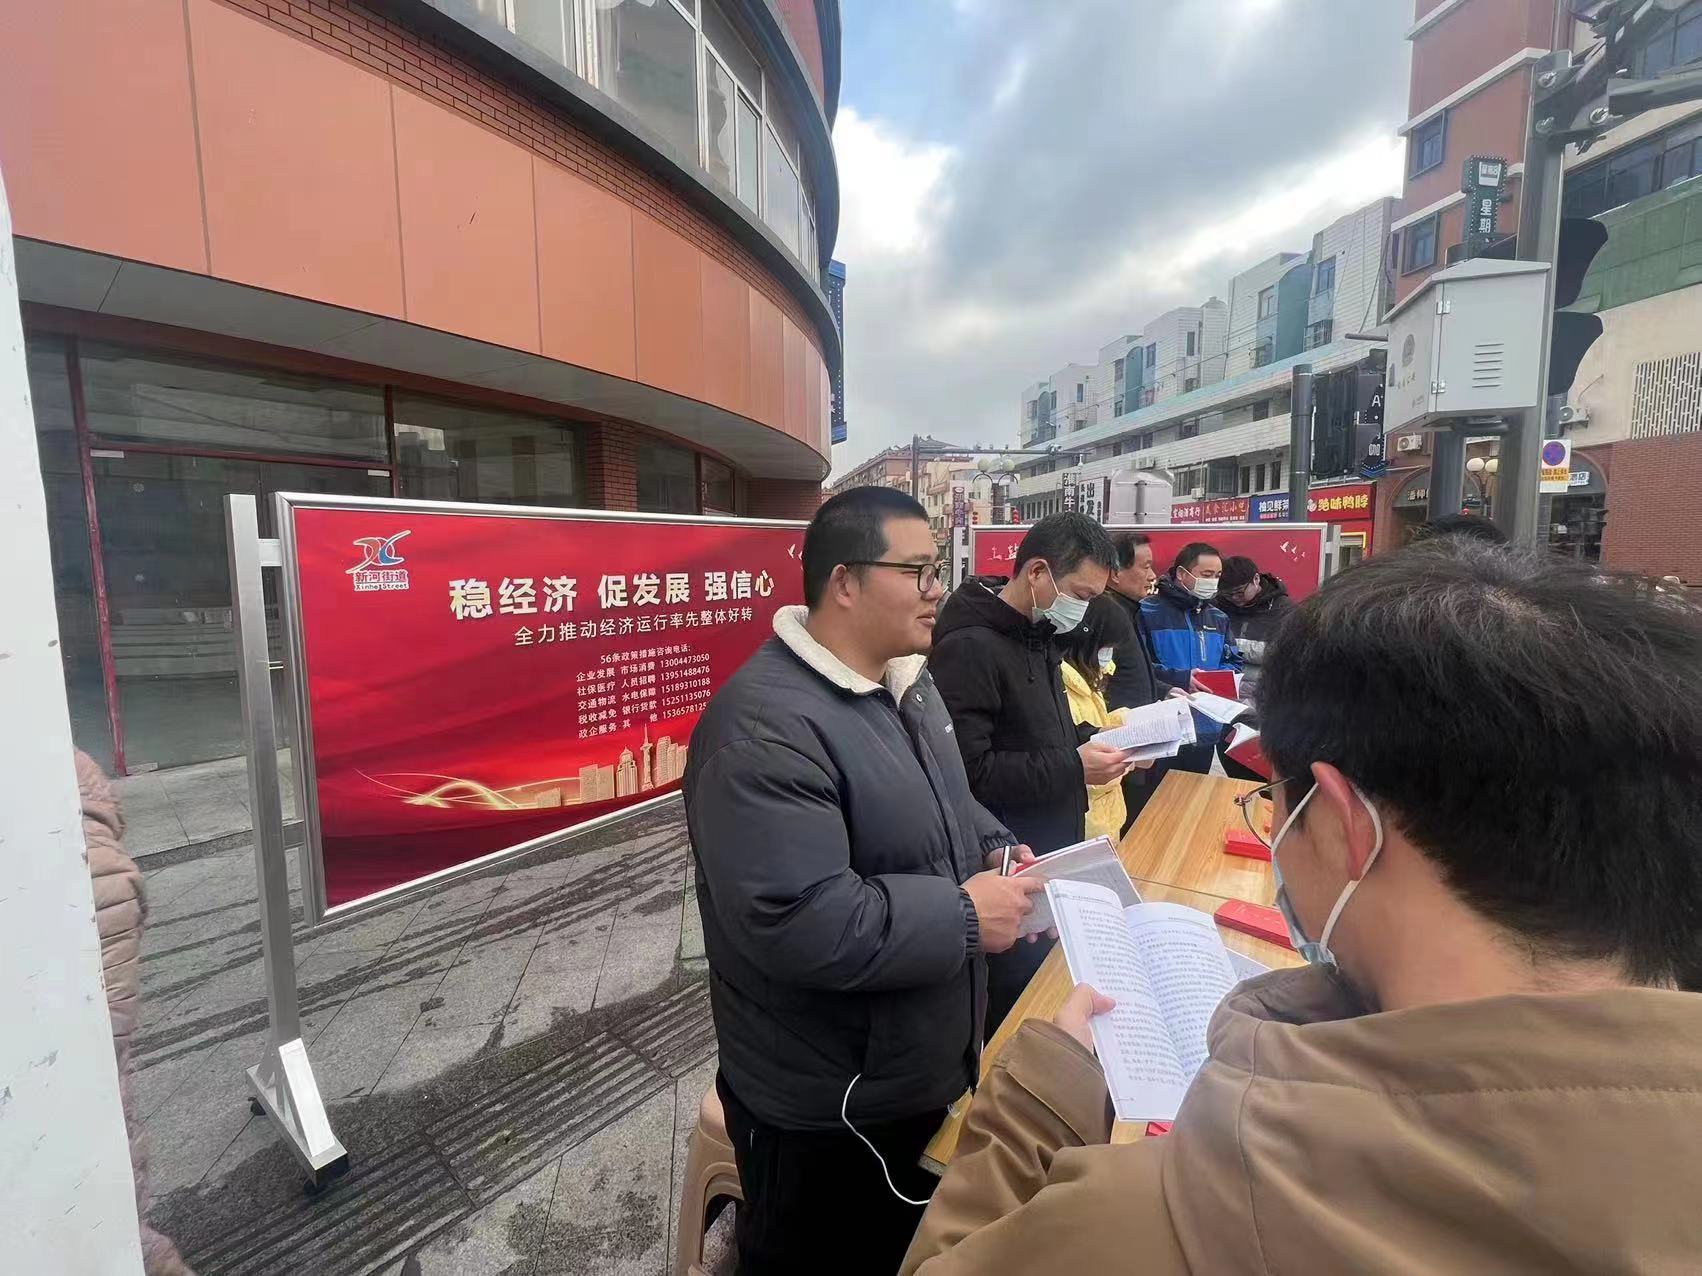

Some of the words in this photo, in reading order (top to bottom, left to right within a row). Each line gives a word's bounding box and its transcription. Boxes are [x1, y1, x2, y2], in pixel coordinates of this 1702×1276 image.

[1318, 494, 1369, 512] 绝味鸭脖
[355, 571, 408, 583] 新河街道
[448, 575, 577, 621] 稳经济
[597, 573, 691, 609] 促发展
[704, 569, 774, 601] 强信心
[514, 606, 753, 647] 全力推动经济运行率先整体好转
[576, 667, 616, 682] 企业发展
[621, 661, 655, 675] 市场消费
[660, 653, 710, 668] 13004473050
[600, 644, 691, 664] 56条政策措施咨询电话:
[577, 681, 616, 696] 社保医疗
[621, 674, 656, 688] 人员招聘
[660, 665, 710, 681] 13951488476
[578, 695, 616, 711] 交通物流
[622, 688, 656, 702] 水电保障
[661, 677, 711, 694] 15189310188
[578, 708, 617, 724] 税收减免
[622, 700, 657, 715] 银行贷款
[662, 690, 711, 707] 15251135076
[578, 722, 617, 739] 政企服务
[662, 702, 707, 720] 1536578125
